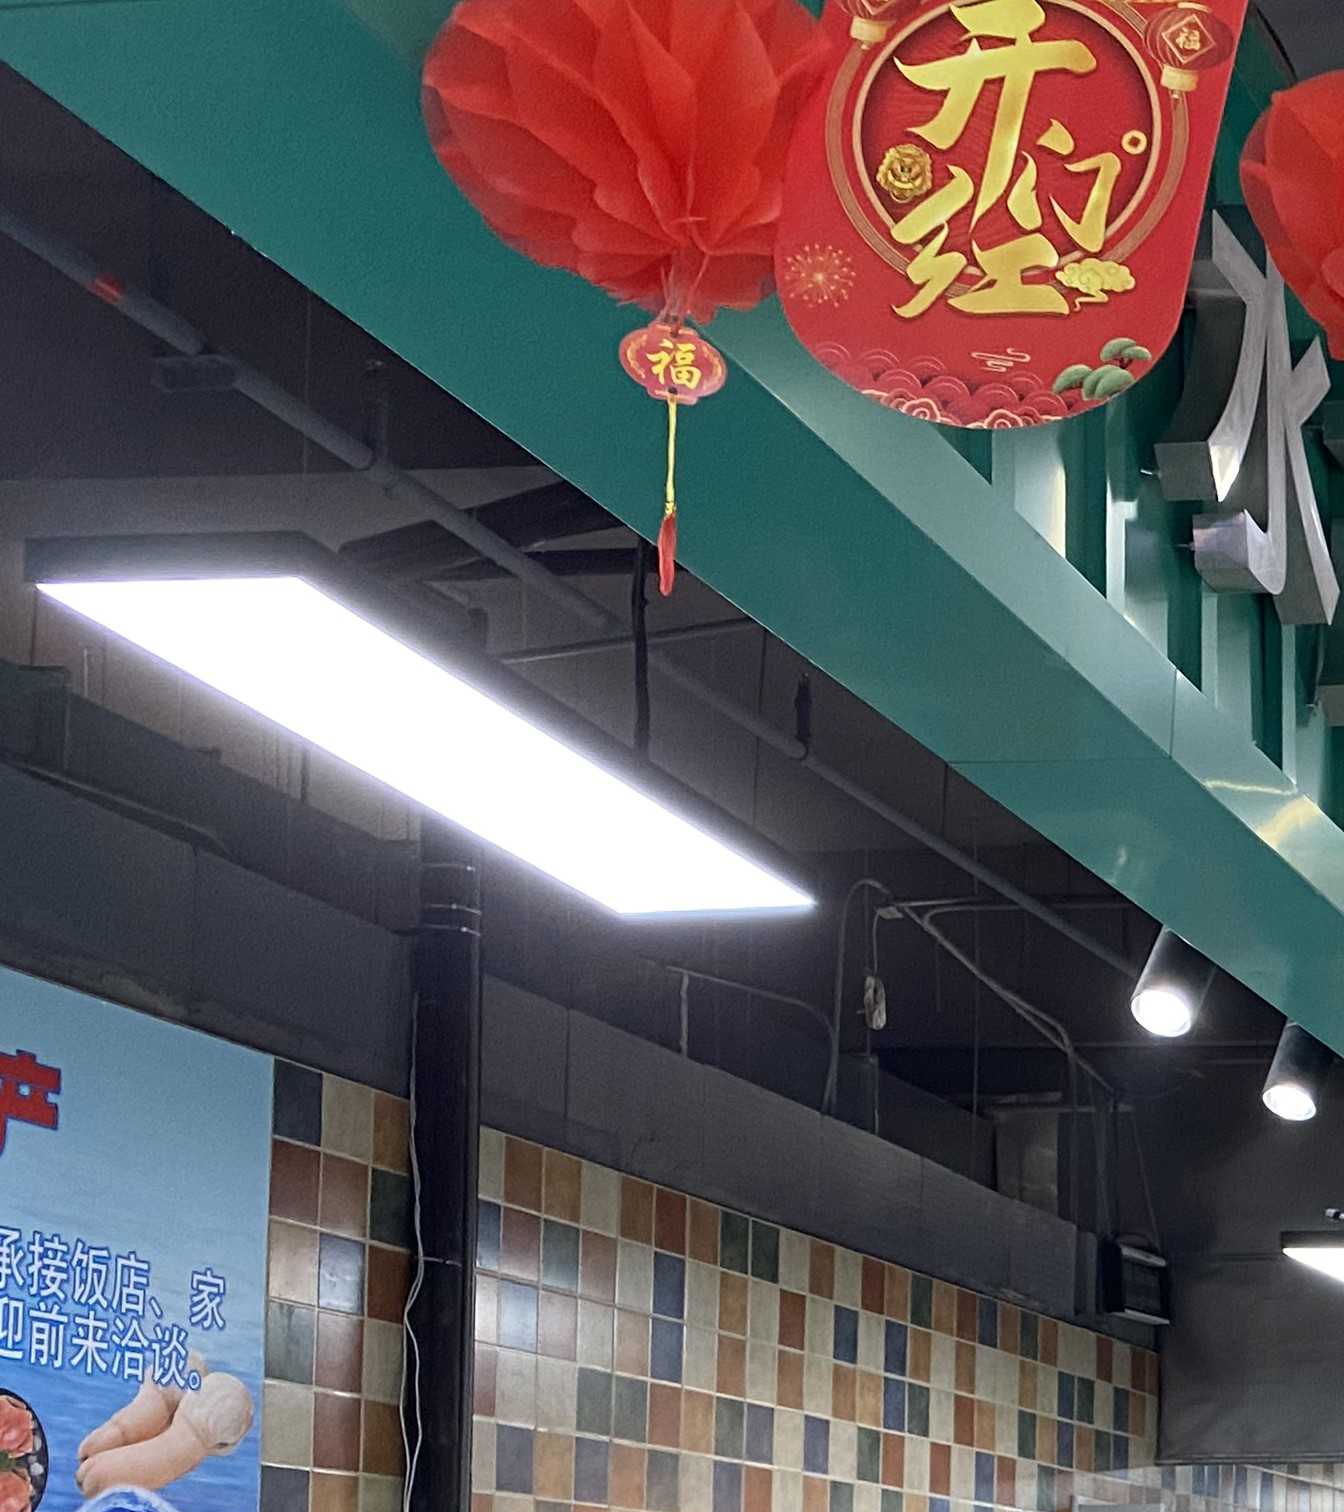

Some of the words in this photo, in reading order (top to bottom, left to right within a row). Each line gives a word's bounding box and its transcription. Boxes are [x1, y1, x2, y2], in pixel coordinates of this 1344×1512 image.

[892, 0, 1122, 319] 开门红
[646, 338, 700, 390] 福
